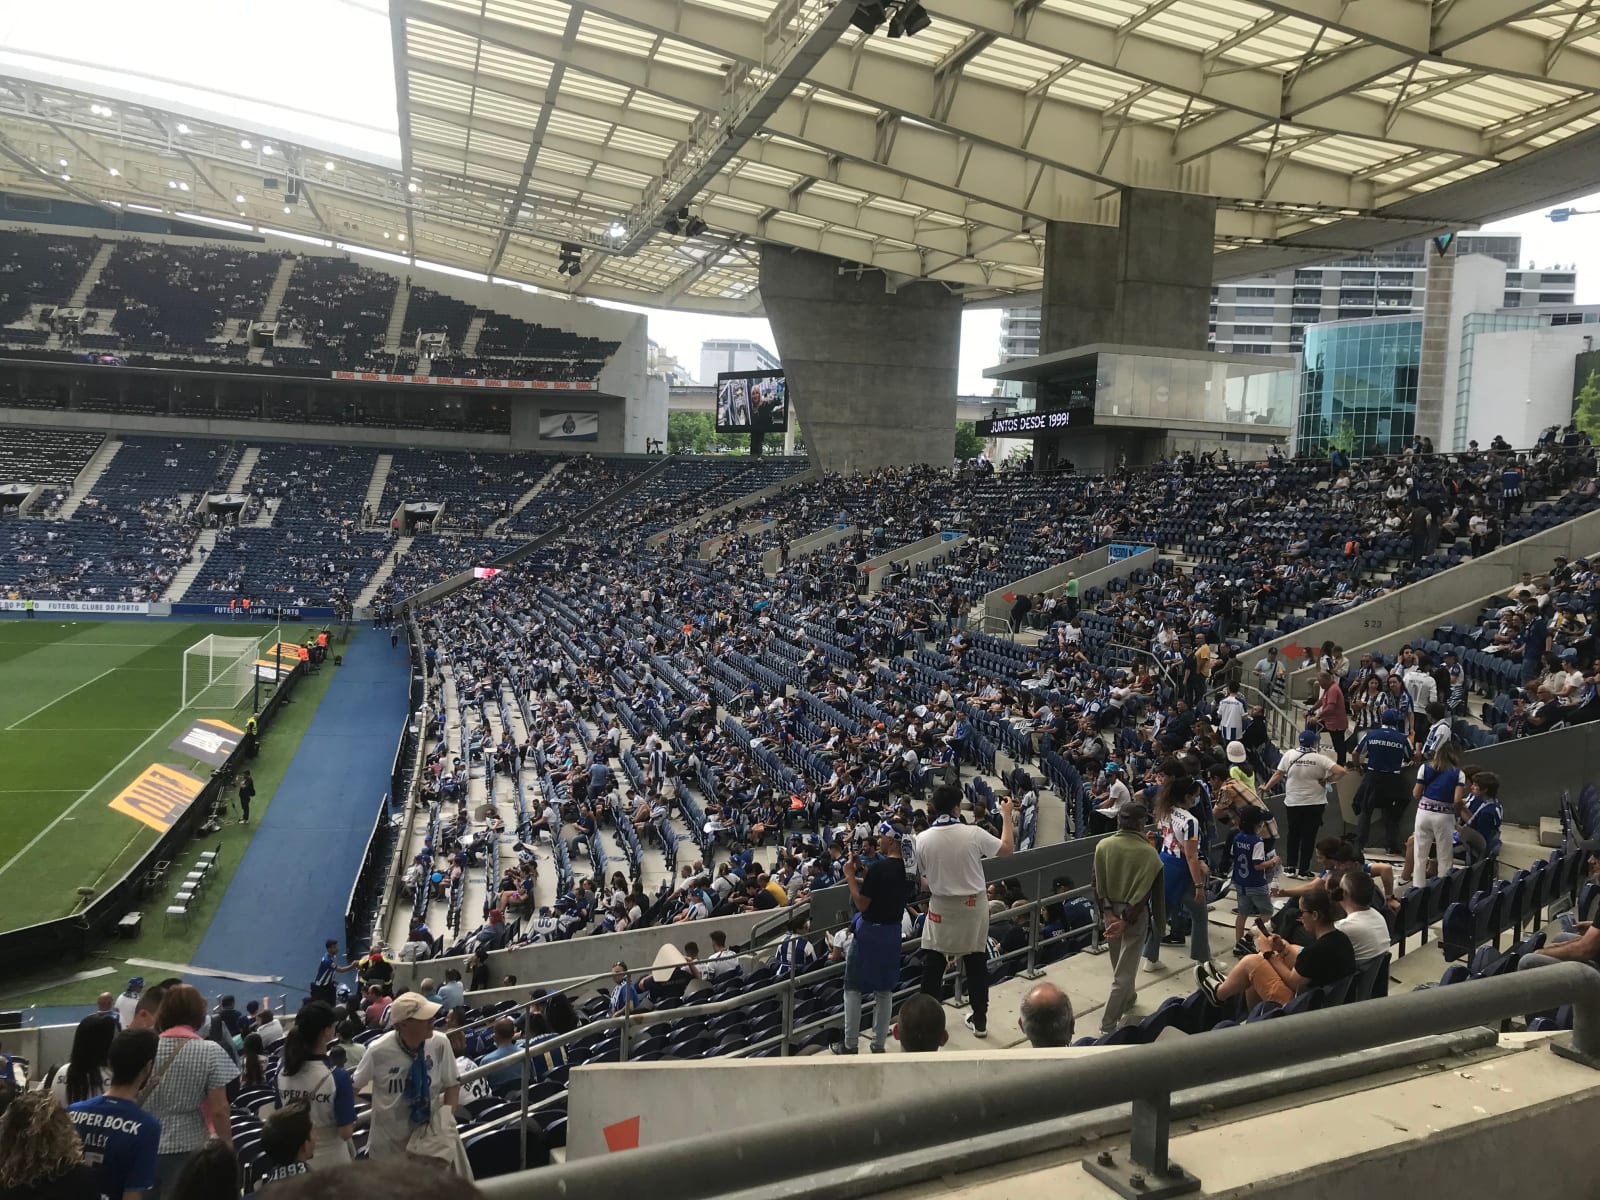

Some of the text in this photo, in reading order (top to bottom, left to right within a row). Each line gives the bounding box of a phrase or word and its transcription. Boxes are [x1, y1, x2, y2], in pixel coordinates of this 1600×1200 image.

[990, 412, 1070, 434] JUNTOS DESDE 1999!
[16, 601, 40, 609] POO
[48, 602, 140, 613] FUTEBOL CLUBE DO PORTO
[214, 606, 243, 615] FUTEOL
[247, 607, 266, 615] LUBE
[1237, 853, 1250, 879] 3
[70, 1110, 142, 1136] SUPER BOCK
